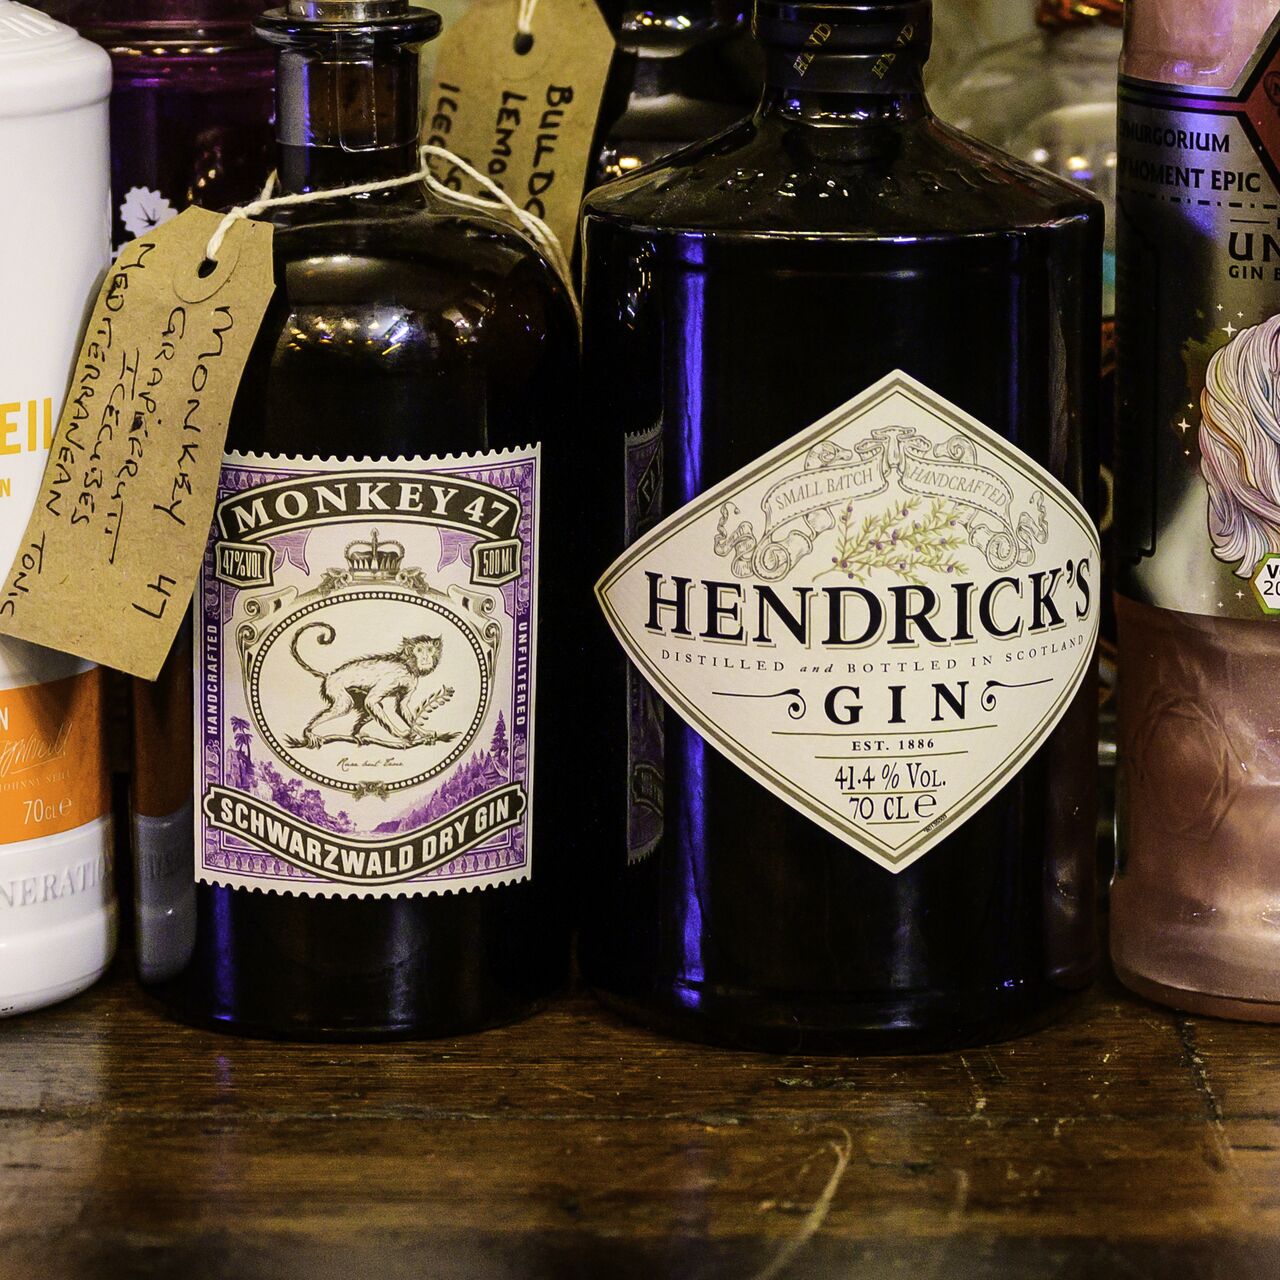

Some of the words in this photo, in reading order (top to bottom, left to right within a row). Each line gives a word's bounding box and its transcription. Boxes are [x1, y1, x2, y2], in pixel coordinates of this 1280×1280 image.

[1120, 120, 1230, 153] MURGORIUM
[1211, 170, 1261, 193] EPIC
[1229, 265, 1264, 281] GIN
[154, 305, 235, 526] MONKEY
[230, 481, 460, 533] MONKEY
[463, 495, 510, 529] 47
[775, 481, 823, 510] SMALL
[827, 468, 873, 494] BATCH
[909, 468, 1008, 508] HANDCRAFTED
[0, 530, 46, 618] TONIC
[132, 575, 176, 620] 47
[644, 557, 1092, 648] HENDRICK'S
[516, 620, 528, 728] UNFILTERED
[661, 649, 785, 672] DISTILLED
[799, 663, 834, 674] and
[848, 658, 957, 674] BOTTLED
[971, 654, 994, 668] IN
[1005, 634, 1085, 662] SCOTLAND
[206, 622, 219, 736] HANDCRAFTED
[824, 680, 969, 726] GIN
[851, 740, 890, 751] EST.
[898, 738, 935, 750] 1886
[834, 764, 876, 790] 41.4
[881, 761, 900, 791] %
[848, 796, 875, 820] 70
[220, 797, 414, 877] SCHWARZWALD
[421, 817, 470, 862] DRY
[475, 795, 510, 834] GIN
